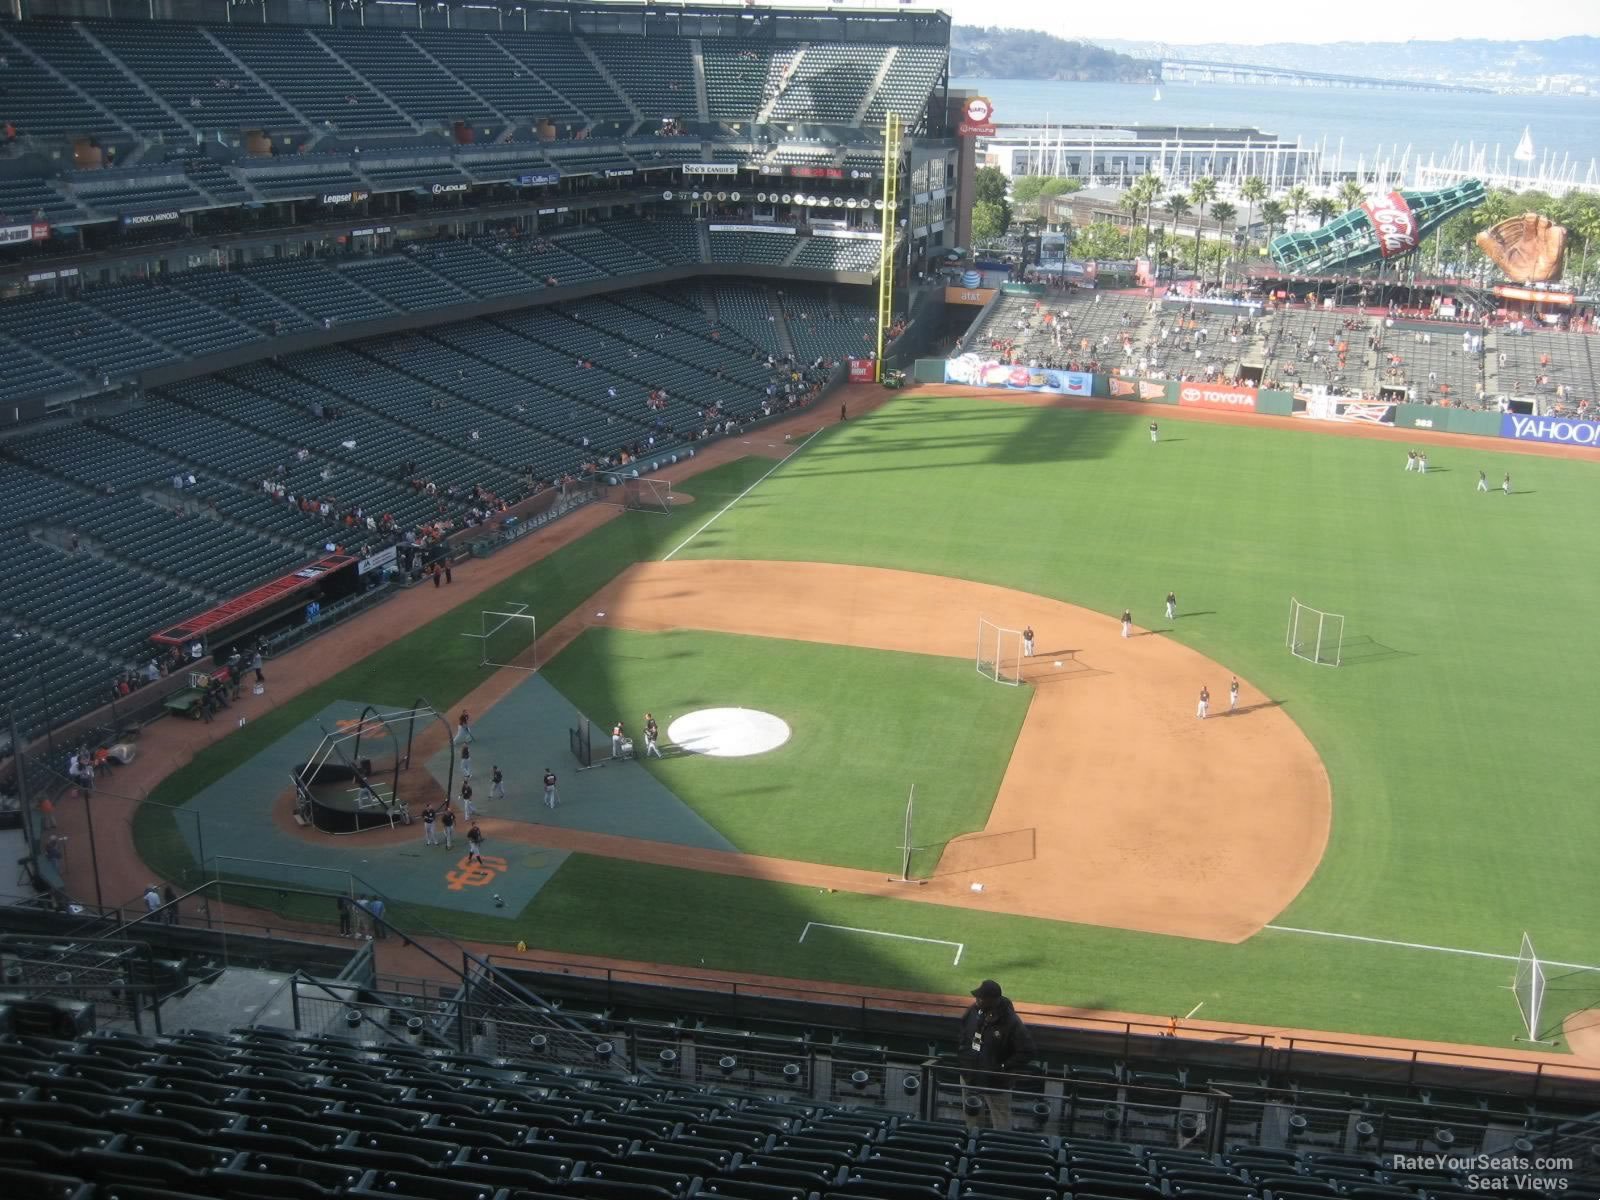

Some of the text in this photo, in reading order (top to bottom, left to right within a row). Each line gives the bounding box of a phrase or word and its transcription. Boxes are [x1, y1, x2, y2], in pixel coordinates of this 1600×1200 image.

[684, 165, 706, 173] See's
[132, 211, 179, 224] KONICA MINOLTA
[1203, 391, 1254, 405] TOYOTA
